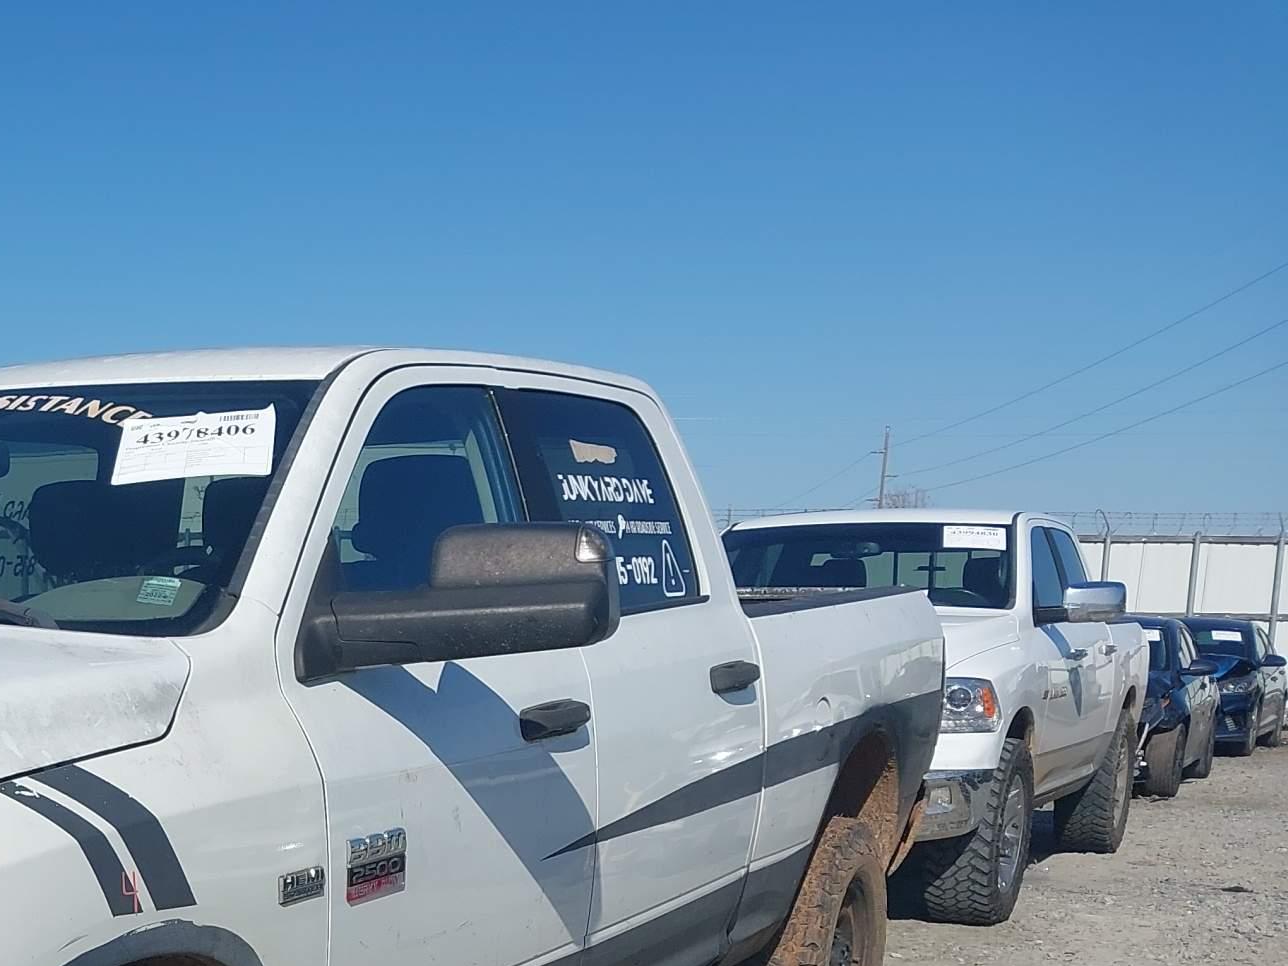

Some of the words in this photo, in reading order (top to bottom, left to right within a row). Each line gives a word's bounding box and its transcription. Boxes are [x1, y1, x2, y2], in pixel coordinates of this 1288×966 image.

[136, 423, 256, 445] 43978406
[621, 477, 655, 504] DAVE
[352, 857, 402, 884] 2500
